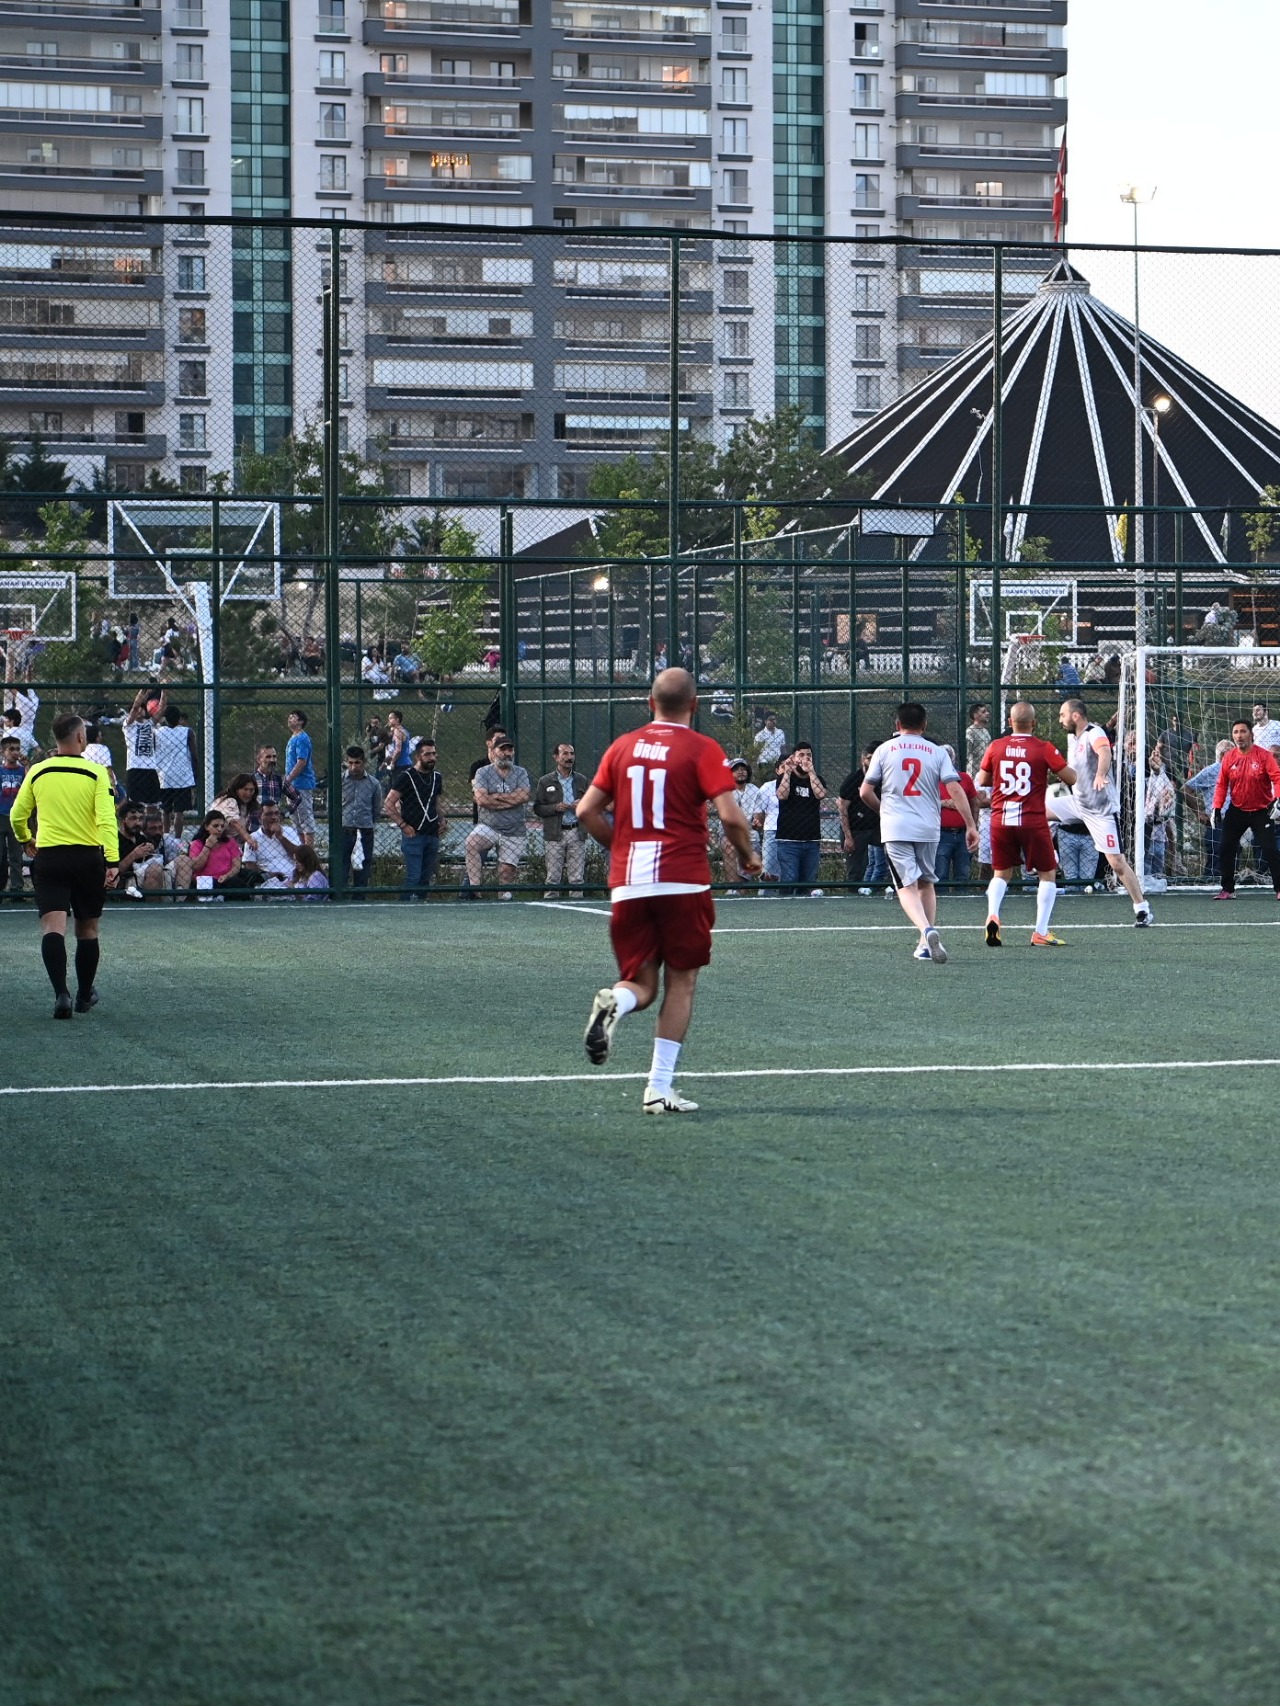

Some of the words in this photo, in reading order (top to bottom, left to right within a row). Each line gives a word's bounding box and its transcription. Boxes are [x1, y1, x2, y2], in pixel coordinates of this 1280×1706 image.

[632, 738, 671, 762] ÜRÜK
[1005, 745, 1027, 759] ÜRÜK
[901, 757, 922, 797] 2
[999, 760, 1032, 797] 58
[626, 764, 667, 830] 11
[1105, 833, 1116, 849] 6
